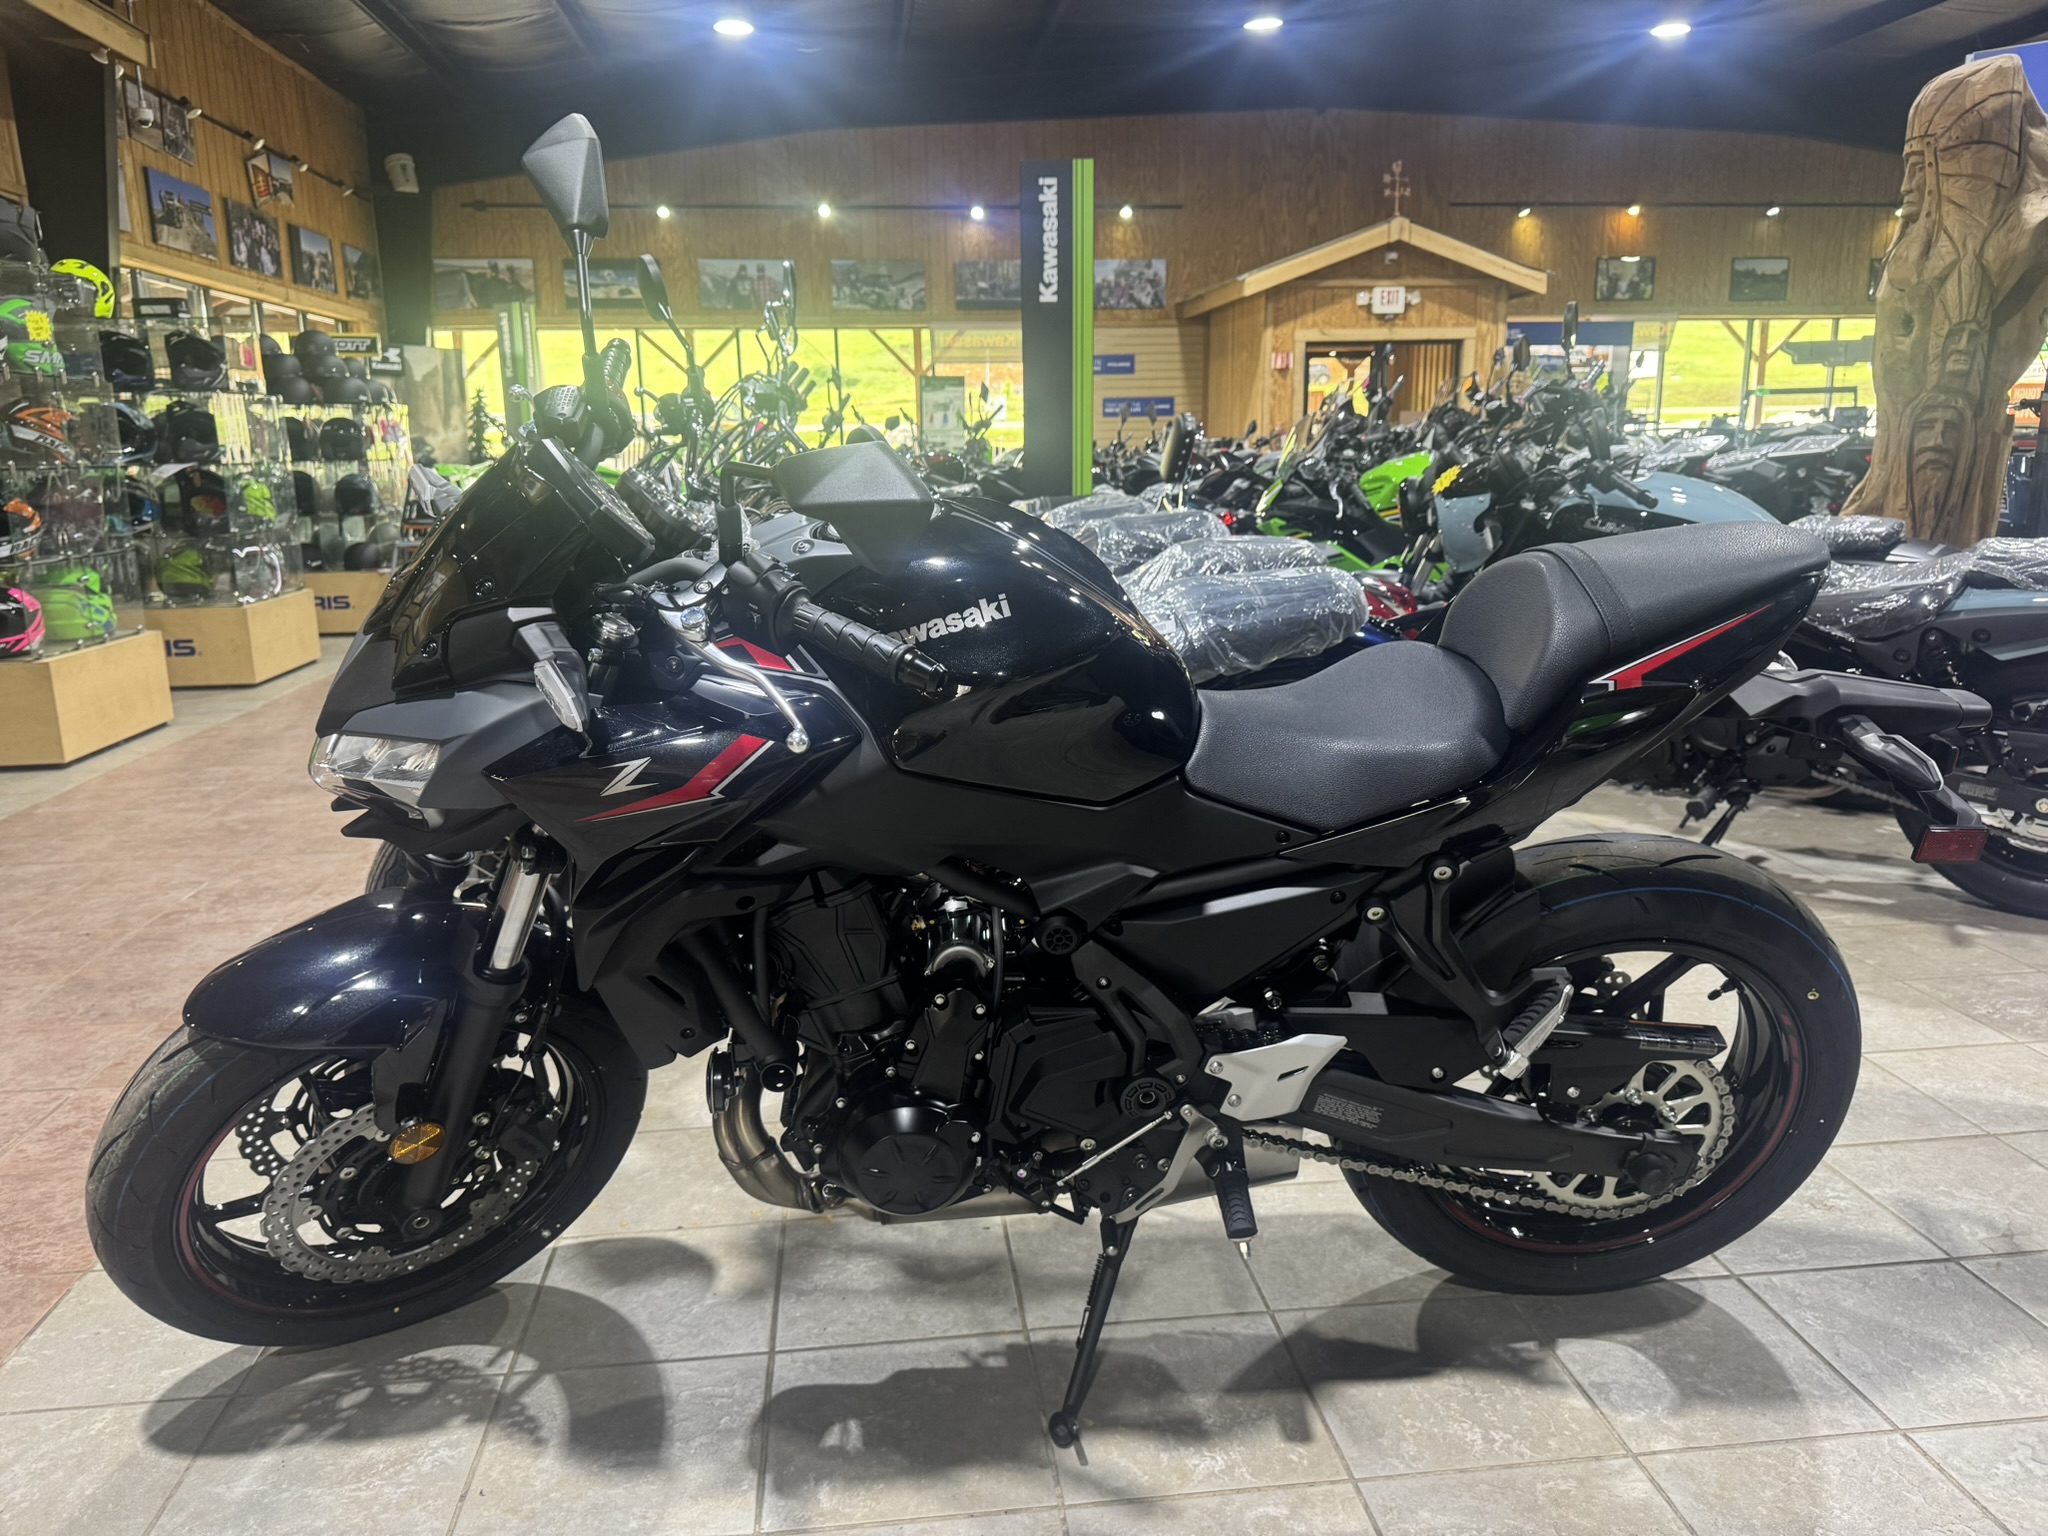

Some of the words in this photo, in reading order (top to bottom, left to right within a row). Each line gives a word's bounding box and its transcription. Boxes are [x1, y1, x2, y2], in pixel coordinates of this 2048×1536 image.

[1038, 177, 1058, 302] Kawasaki
[1380, 290, 1400, 305] EXIT
[334, 338, 371, 351] OTT
[887, 593, 1011, 645] wasaki
